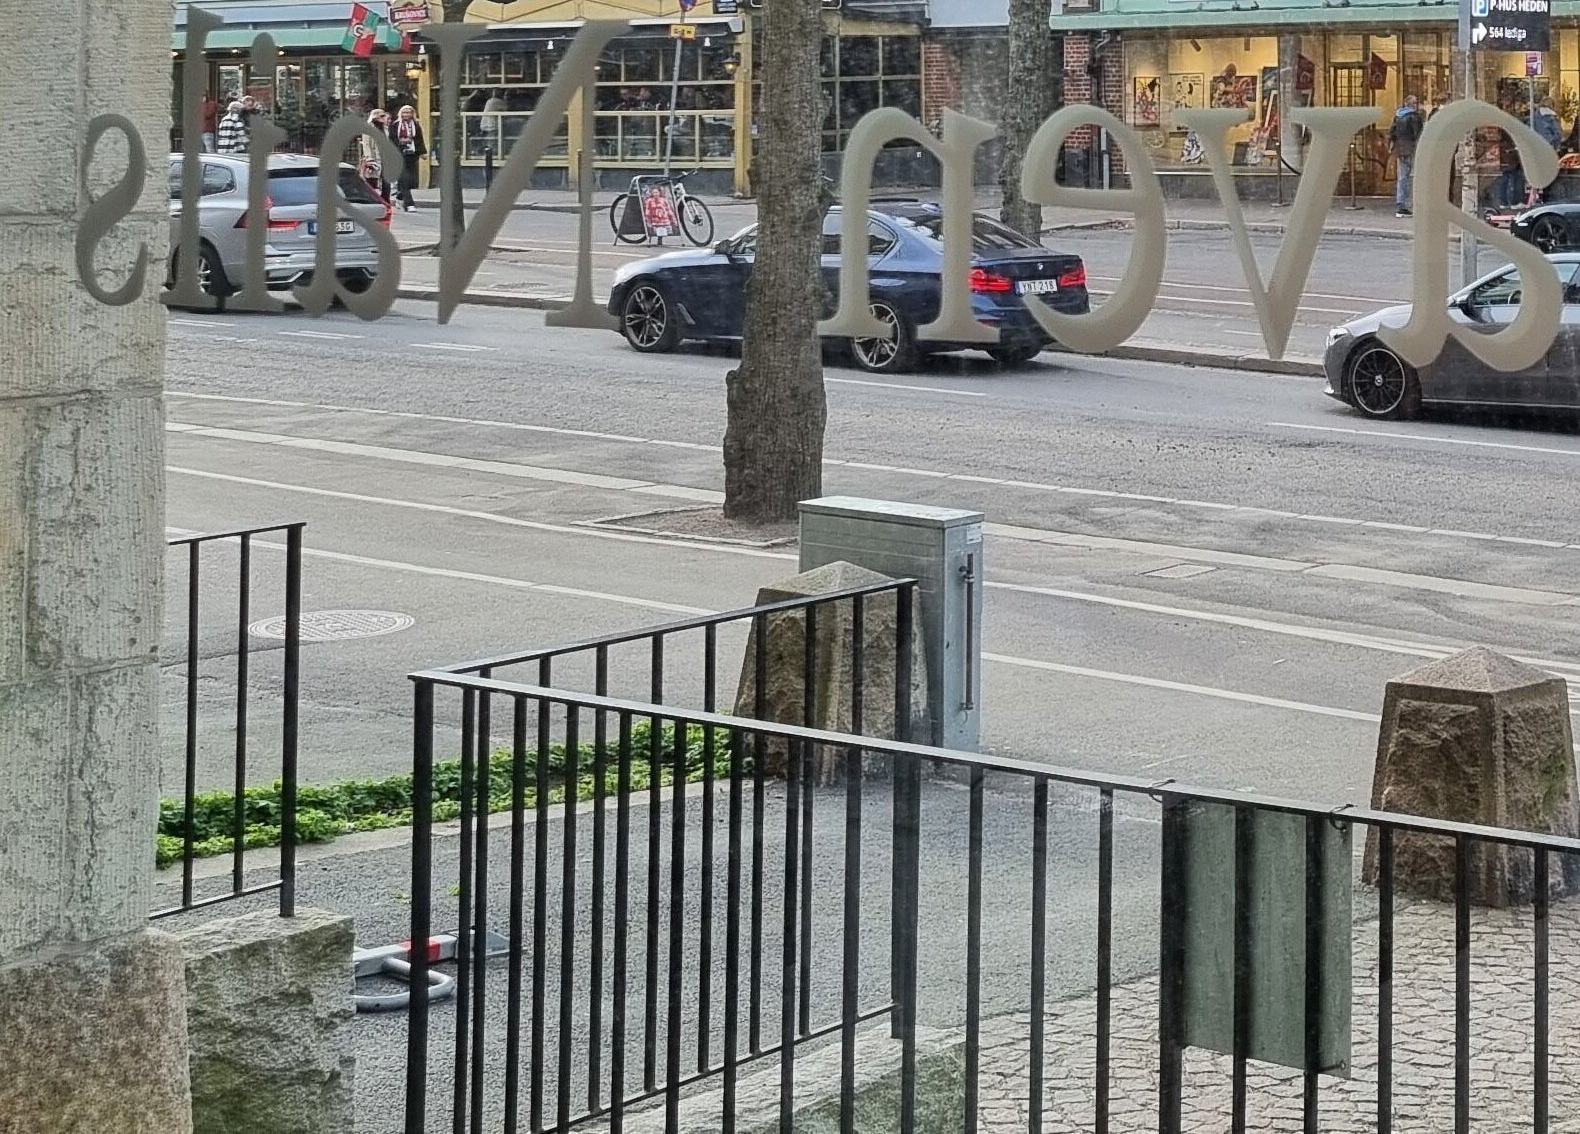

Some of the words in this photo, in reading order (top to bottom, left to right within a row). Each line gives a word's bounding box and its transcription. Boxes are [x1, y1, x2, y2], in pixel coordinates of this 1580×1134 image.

[1518, 0, 1548, 13] HEDEN
[1489, 27, 1503, 38] 564
[1504, 26, 1527, 41] lediga
